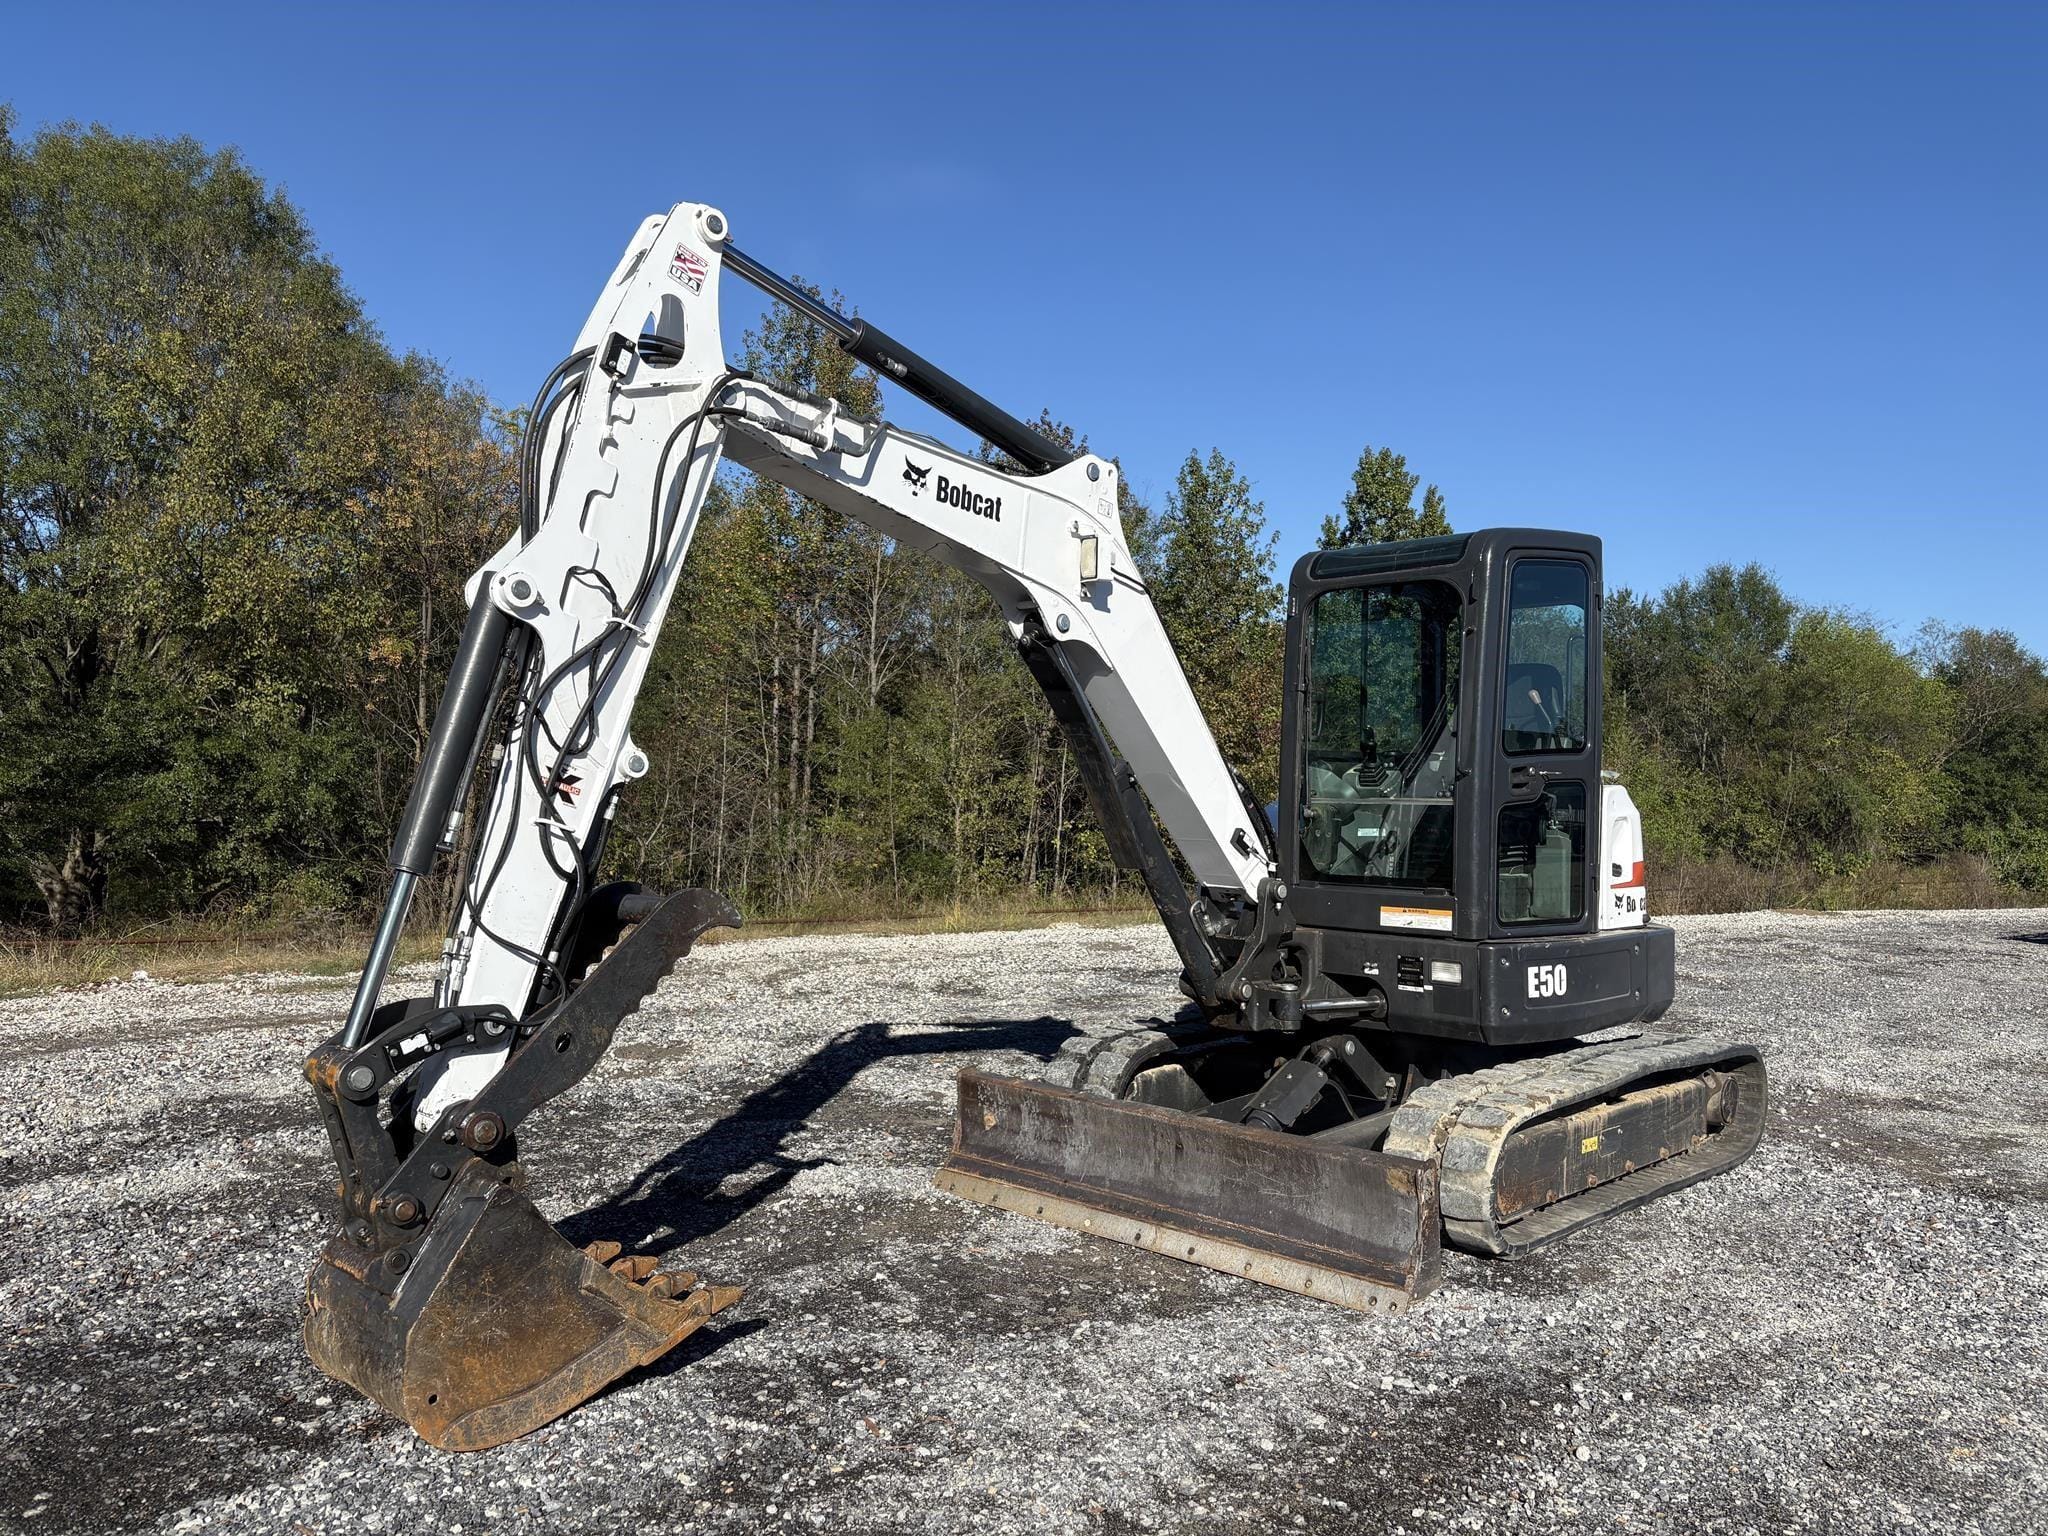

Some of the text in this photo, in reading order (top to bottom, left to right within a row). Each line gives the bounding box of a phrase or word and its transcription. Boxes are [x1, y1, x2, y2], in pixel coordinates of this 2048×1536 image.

[671, 266, 699, 291] USA
[936, 475, 1002, 522] Bobcat
[1528, 964, 1567, 998] E50
